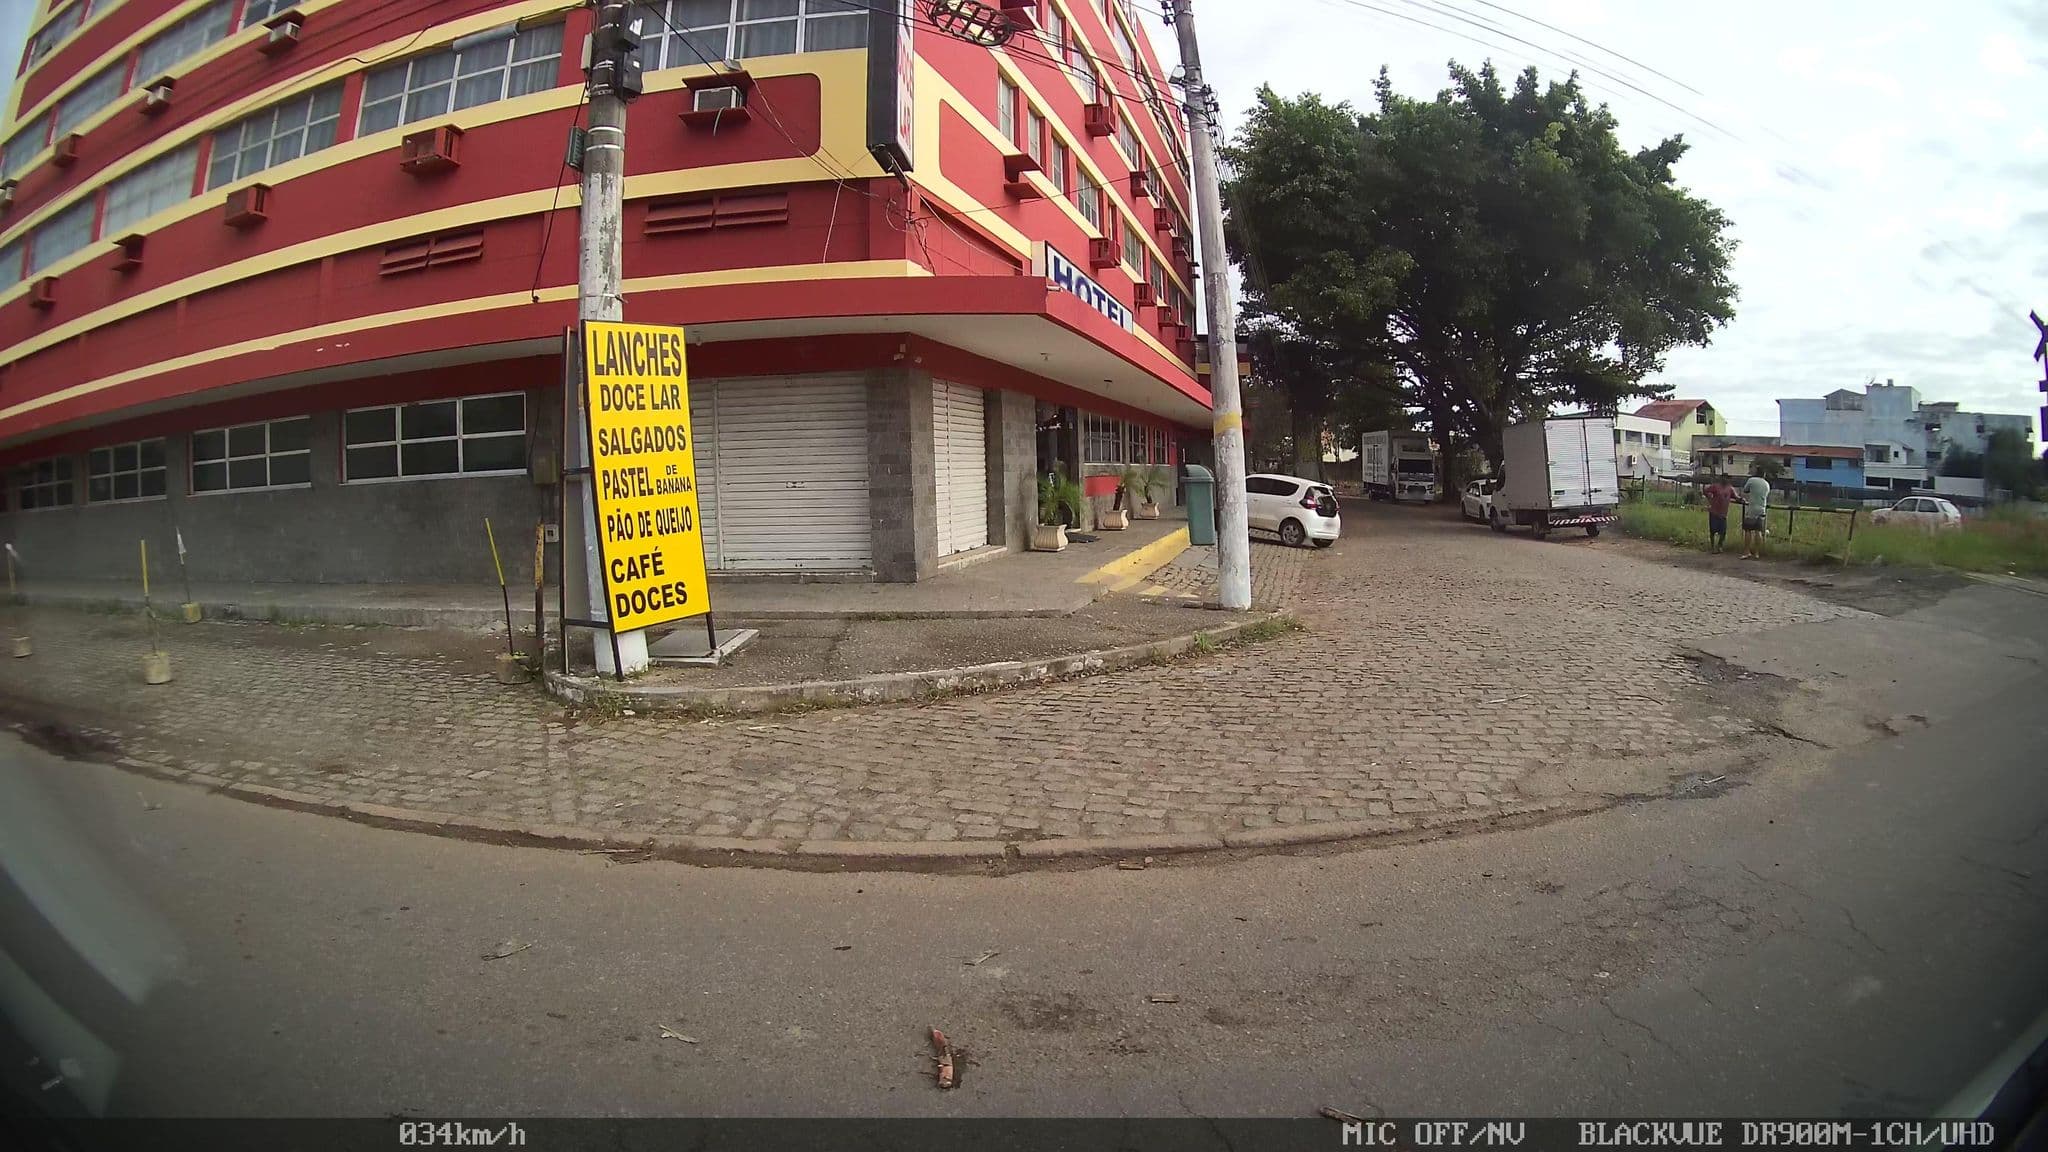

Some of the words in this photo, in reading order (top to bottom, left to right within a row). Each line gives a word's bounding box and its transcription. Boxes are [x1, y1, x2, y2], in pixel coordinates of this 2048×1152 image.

[592, 330, 682, 377] LANCHES
[600, 384, 646, 412] DOCE
[650, 384, 682, 411] LAR
[598, 425, 686, 457] SALGADOS
[602, 467, 654, 500] PASTEL
[656, 476, 692, 496] BANANA
[665, 464, 678, 476] DE
[607, 508, 634, 543] PÃO
[638, 509, 653, 538] DE
[655, 505, 692, 537] QUEIJO
[611, 546, 665, 584] CAFÉ
[615, 581, 688, 619] DOCES
